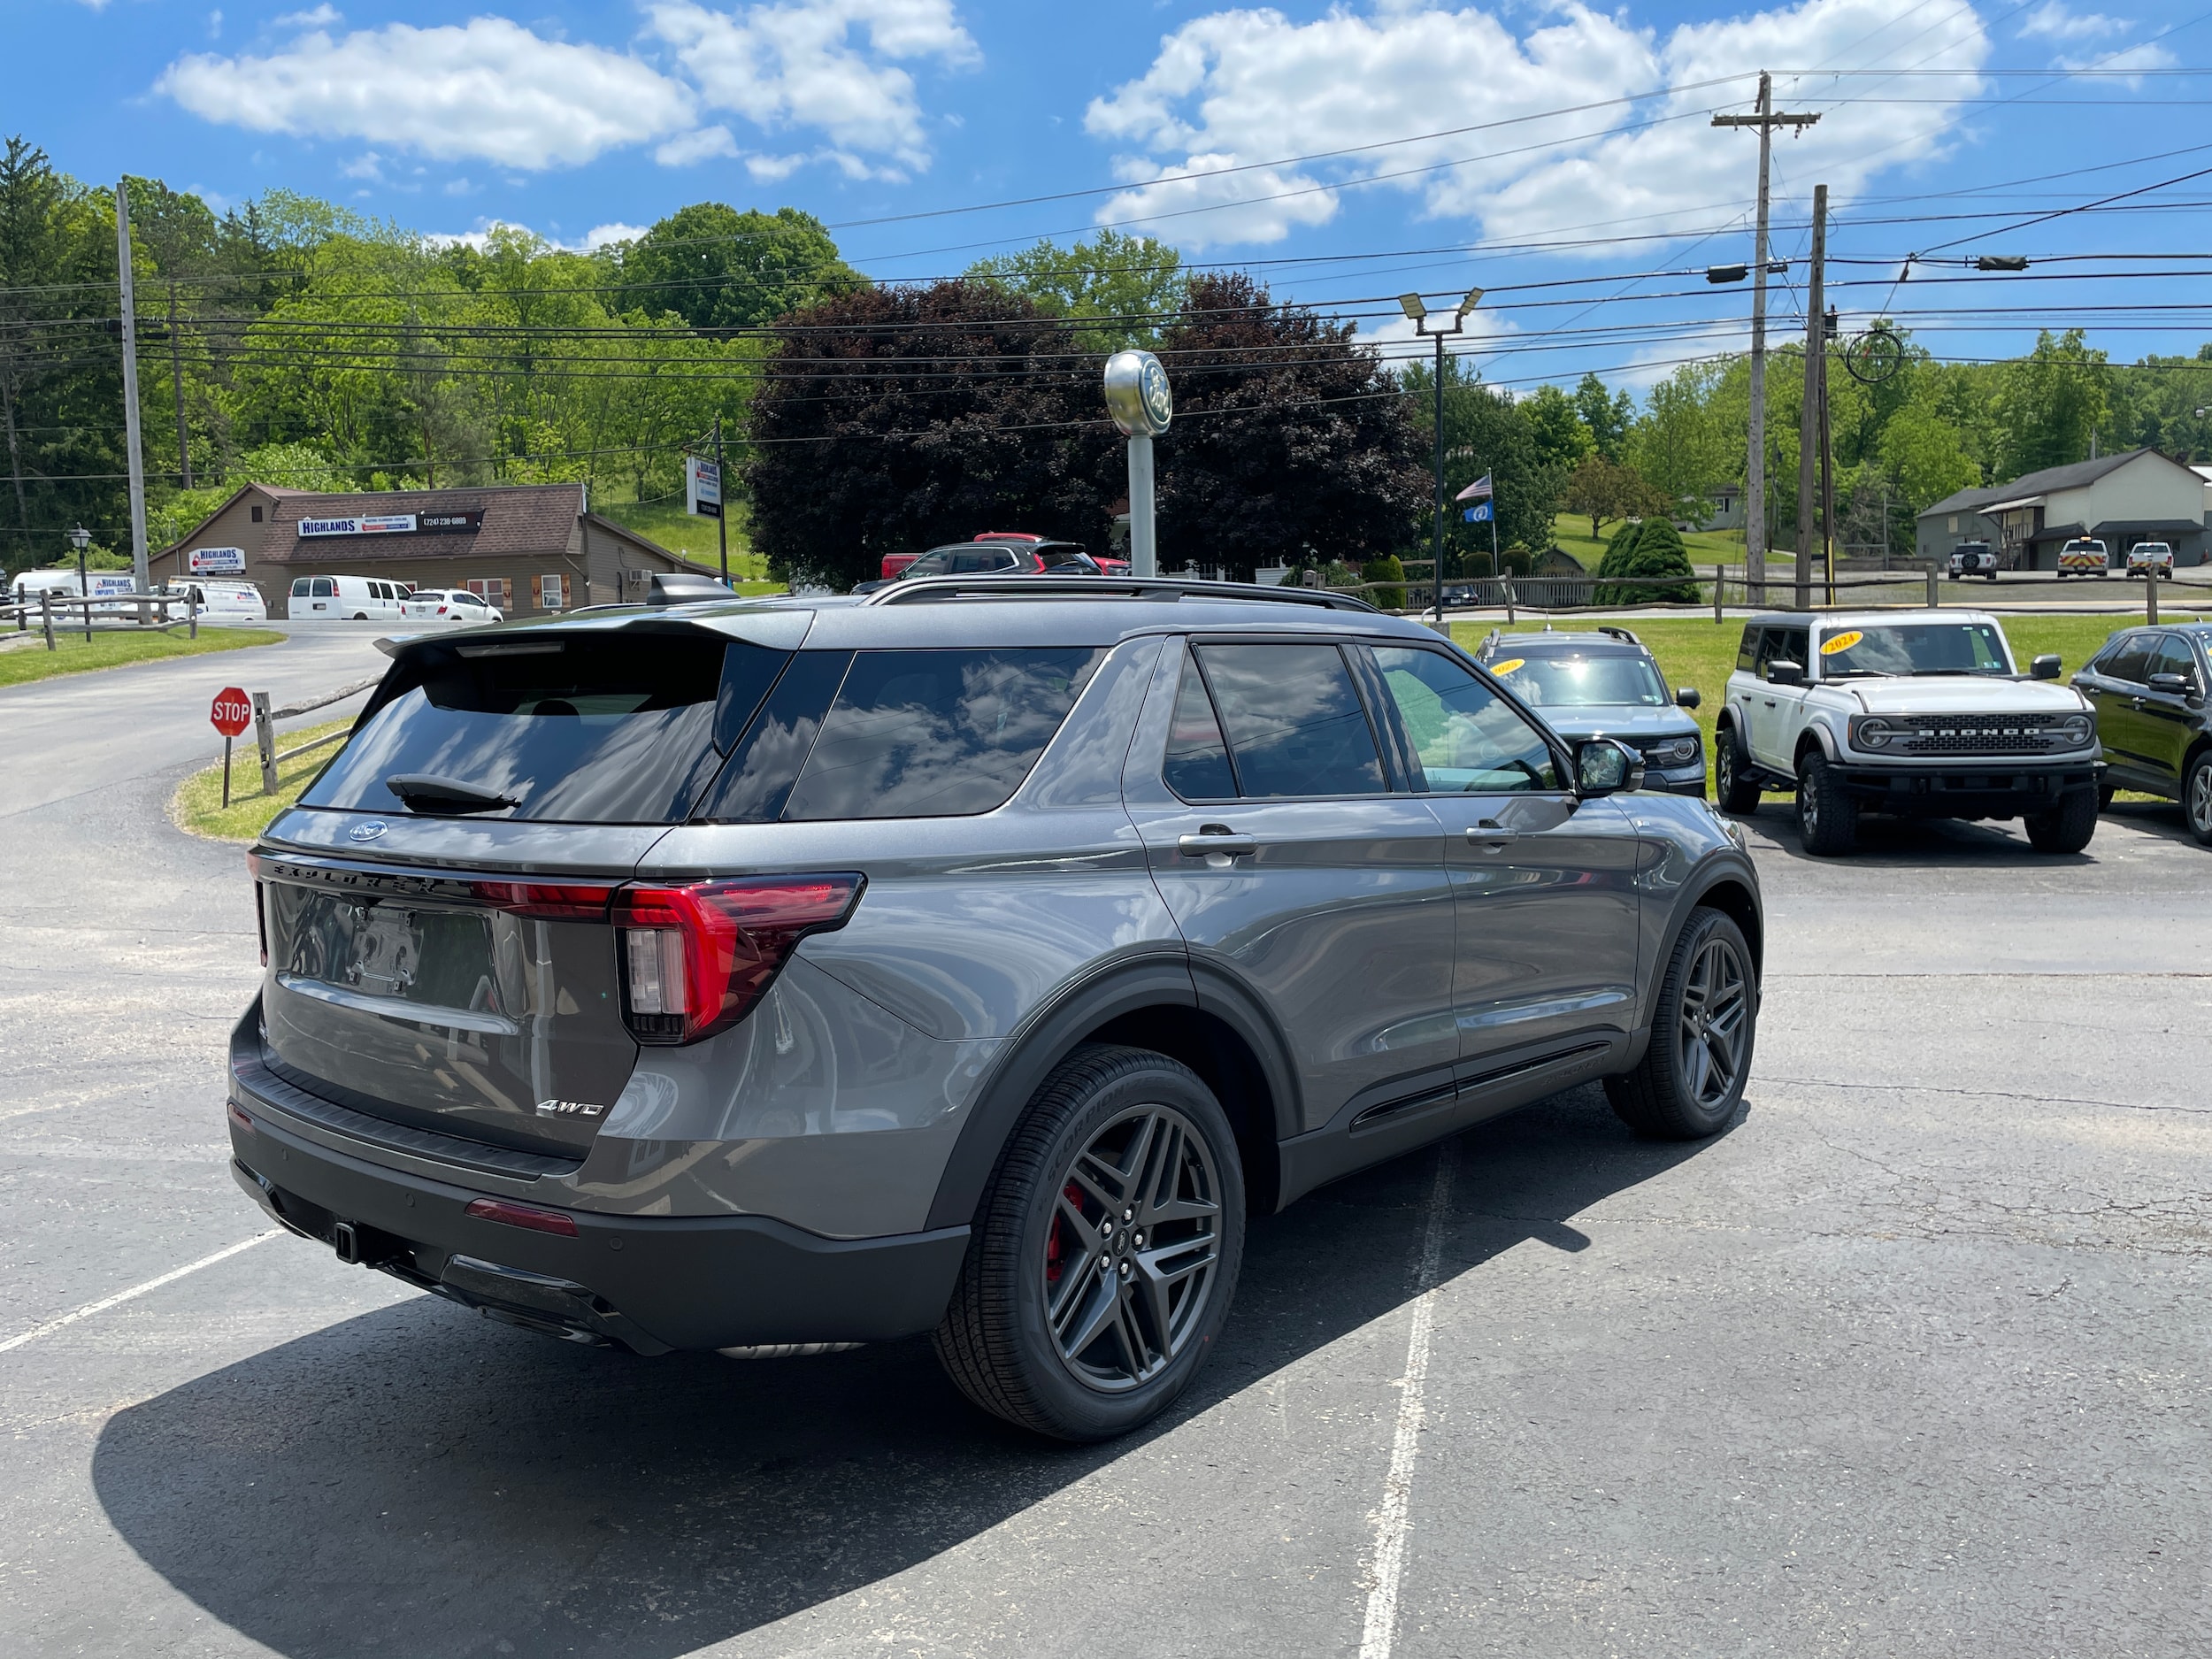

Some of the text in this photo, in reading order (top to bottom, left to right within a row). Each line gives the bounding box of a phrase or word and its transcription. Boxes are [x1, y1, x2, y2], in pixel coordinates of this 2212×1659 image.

[303, 520, 355, 534] HIGHLANDS
[200, 549, 236, 559] HIGHLANDS
[102, 579, 131, 588] HIGHLANDS
[1828, 634, 1855, 652] 2024
[213, 701, 249, 722] STOP
[274, 865, 436, 893] EXPLORER
[536, 1099, 604, 1117] 4WD
